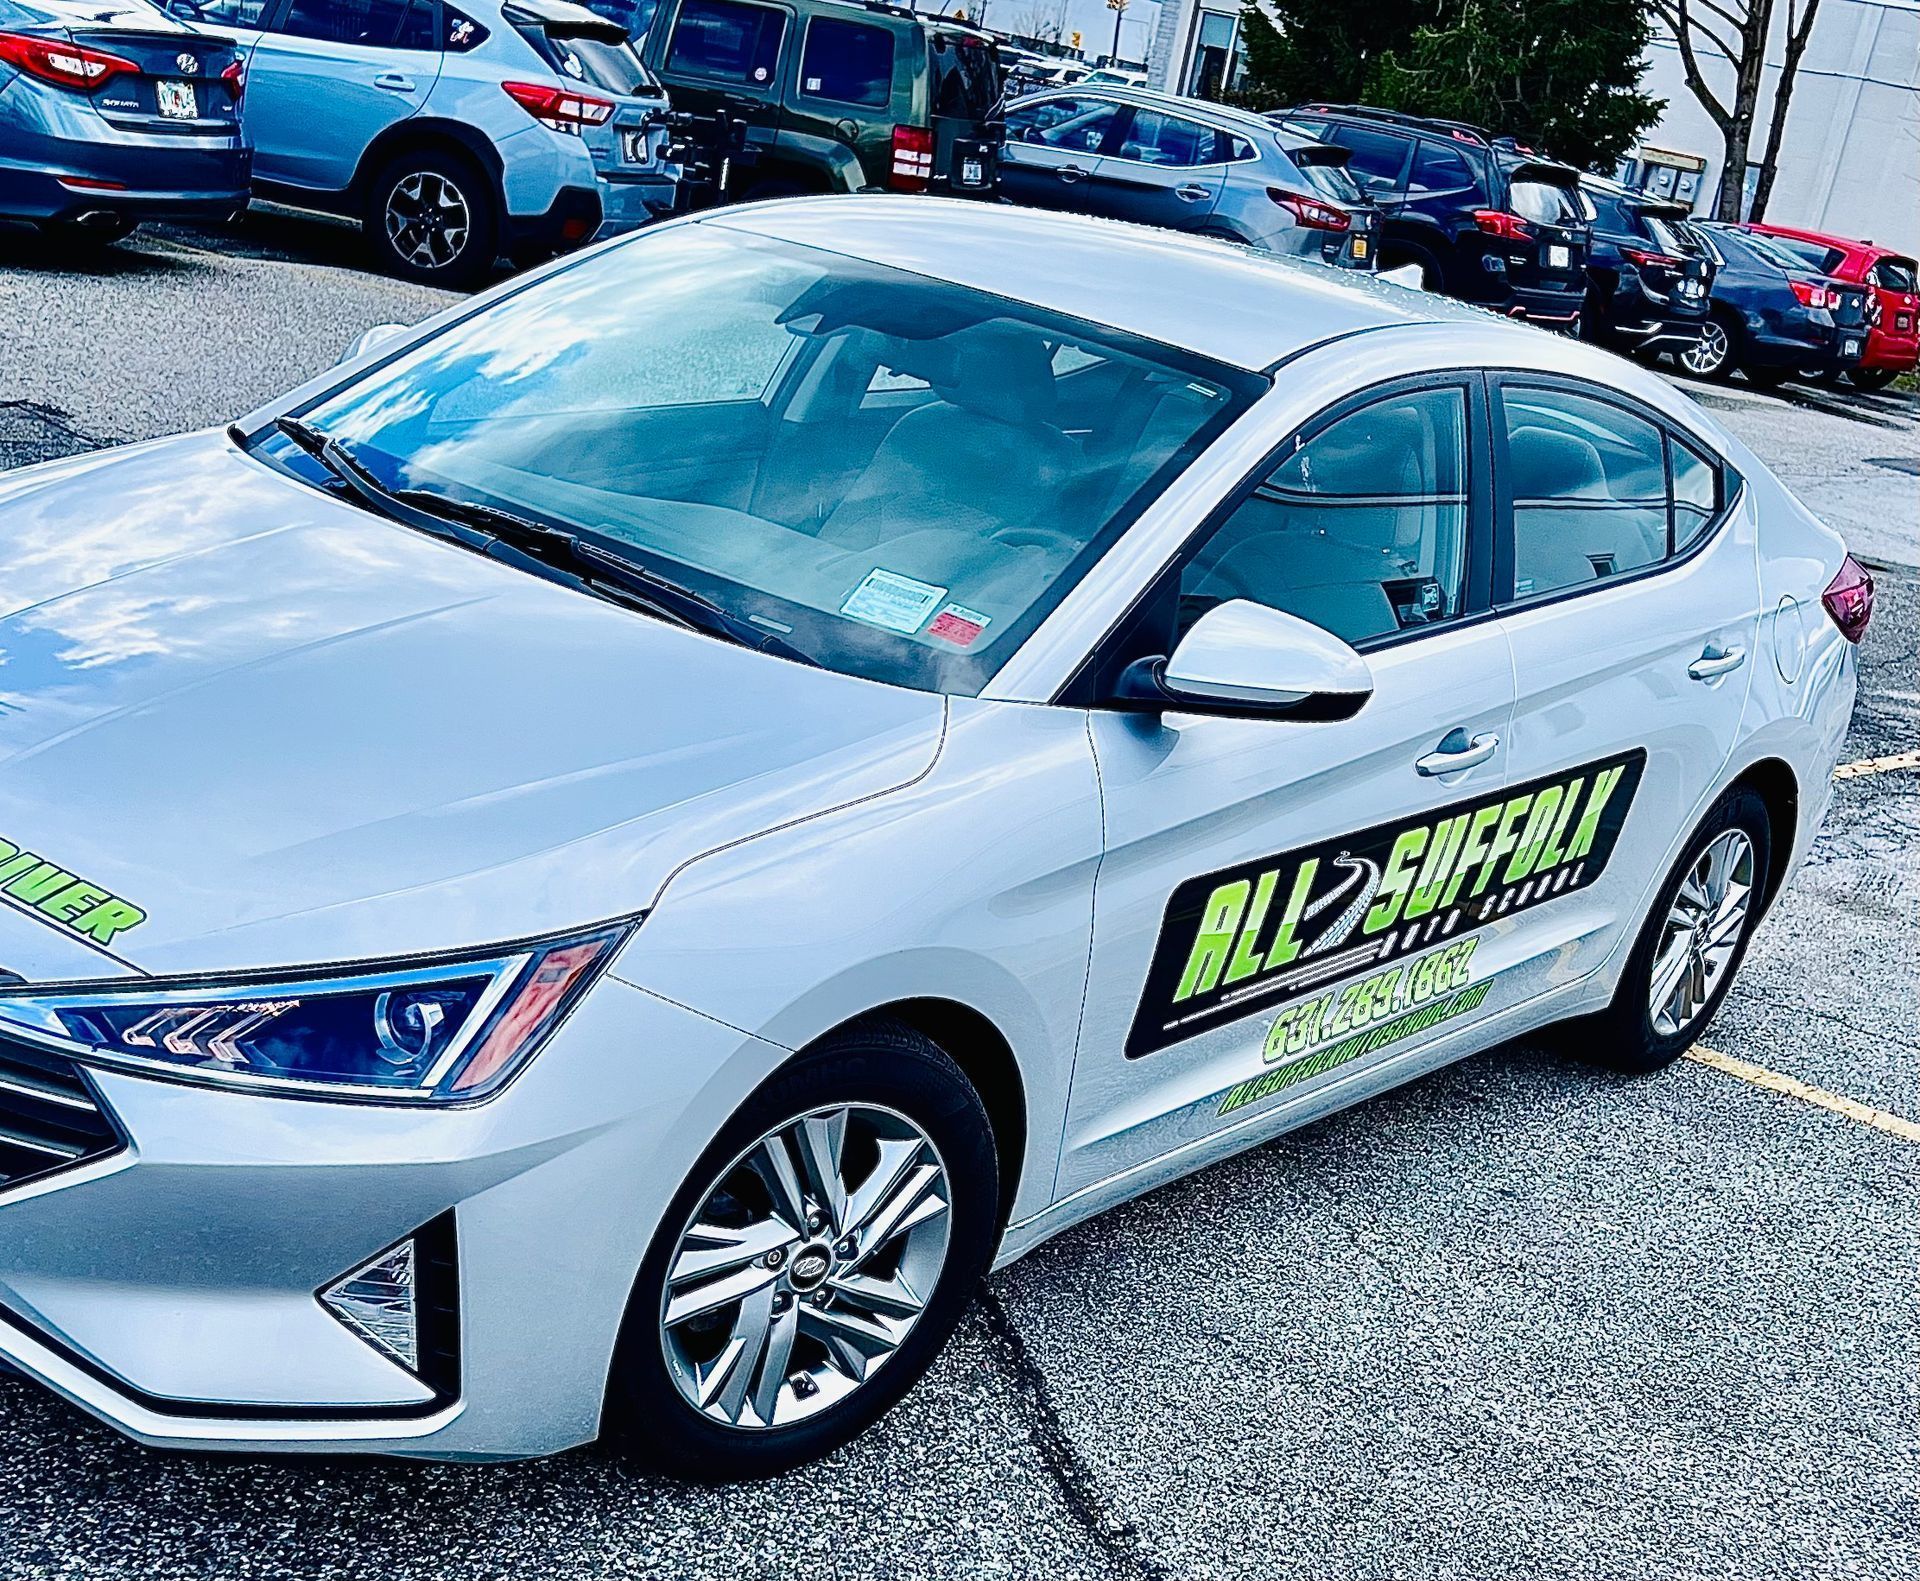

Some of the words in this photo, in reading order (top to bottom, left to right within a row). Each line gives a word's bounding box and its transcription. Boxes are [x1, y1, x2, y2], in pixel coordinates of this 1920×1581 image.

[1173, 857, 1319, 1003] ALL
[1361, 764, 1626, 936] SUFFOLK
[1378, 908, 1461, 958] AUTO
[1478, 862, 1585, 921] SCHOOL
[1262, 935, 1481, 1065] 631.289.1862
